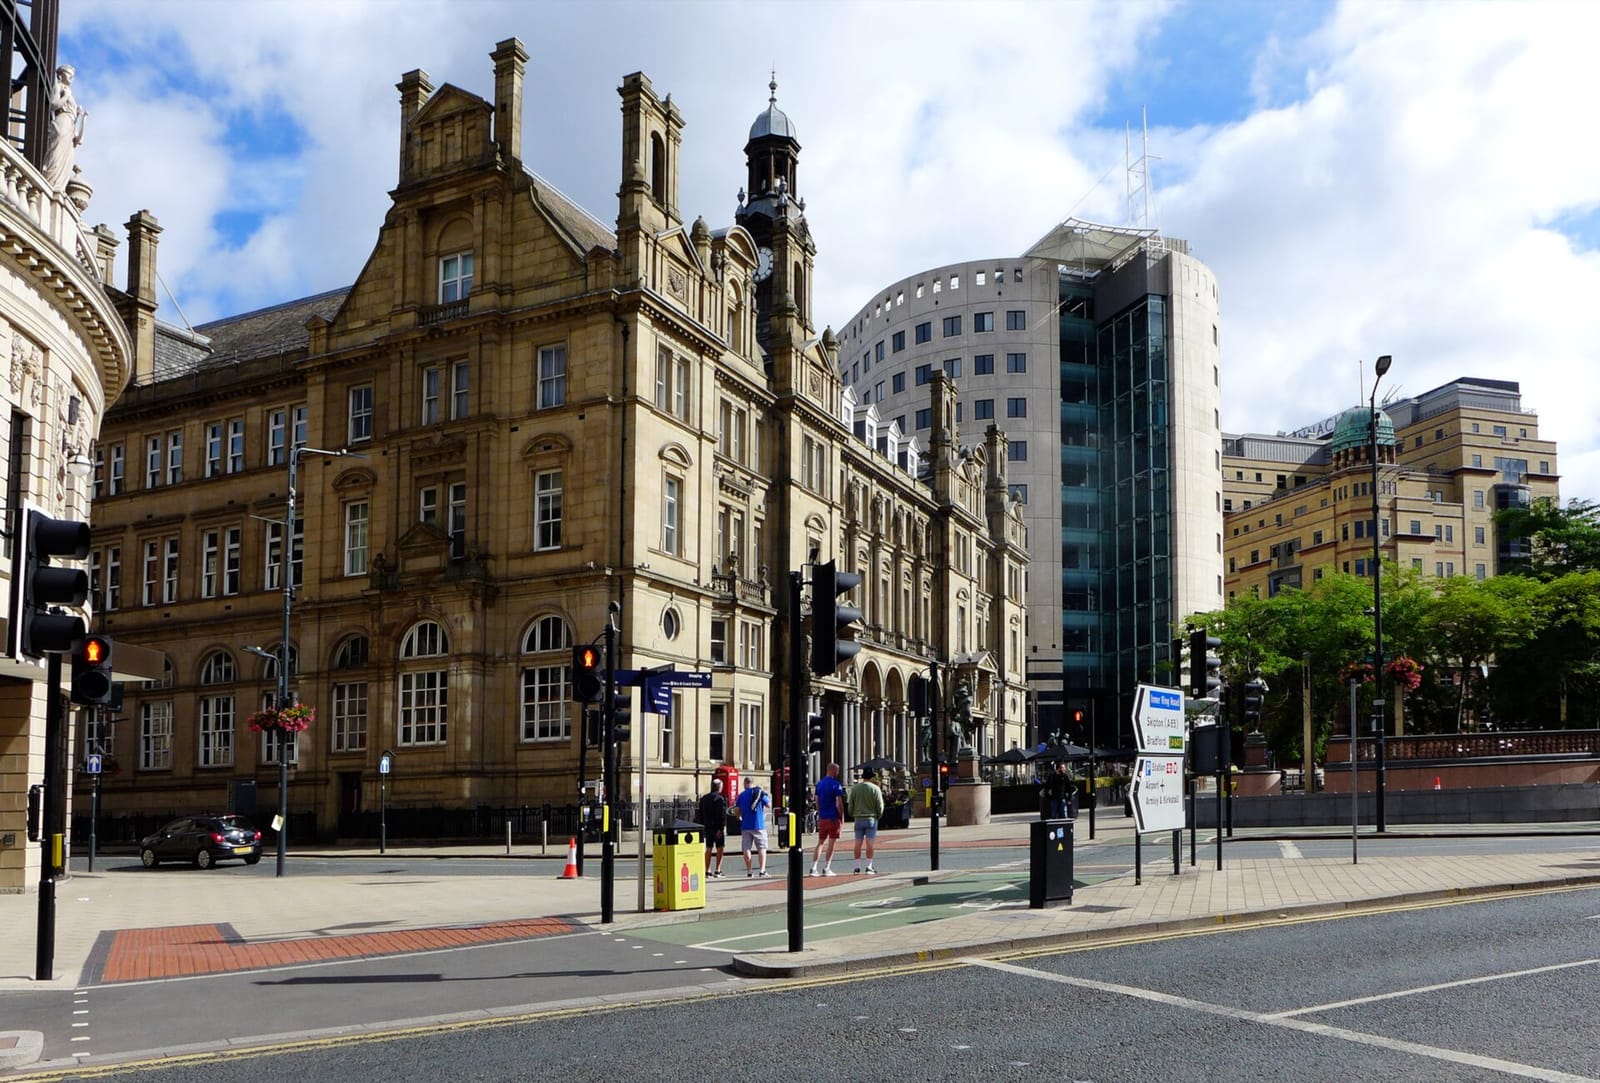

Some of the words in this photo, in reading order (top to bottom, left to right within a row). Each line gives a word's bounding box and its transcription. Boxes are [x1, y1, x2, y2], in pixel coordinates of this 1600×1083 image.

[1161, 696, 1169, 707] Ring
[1170, 696, 1180, 706] Road
[1147, 716, 1163, 728] Skipton
[1147, 736, 1166, 745] Bradford
[1152, 762, 1165, 771] Station
[1146, 781, 1159, 791] Airport
